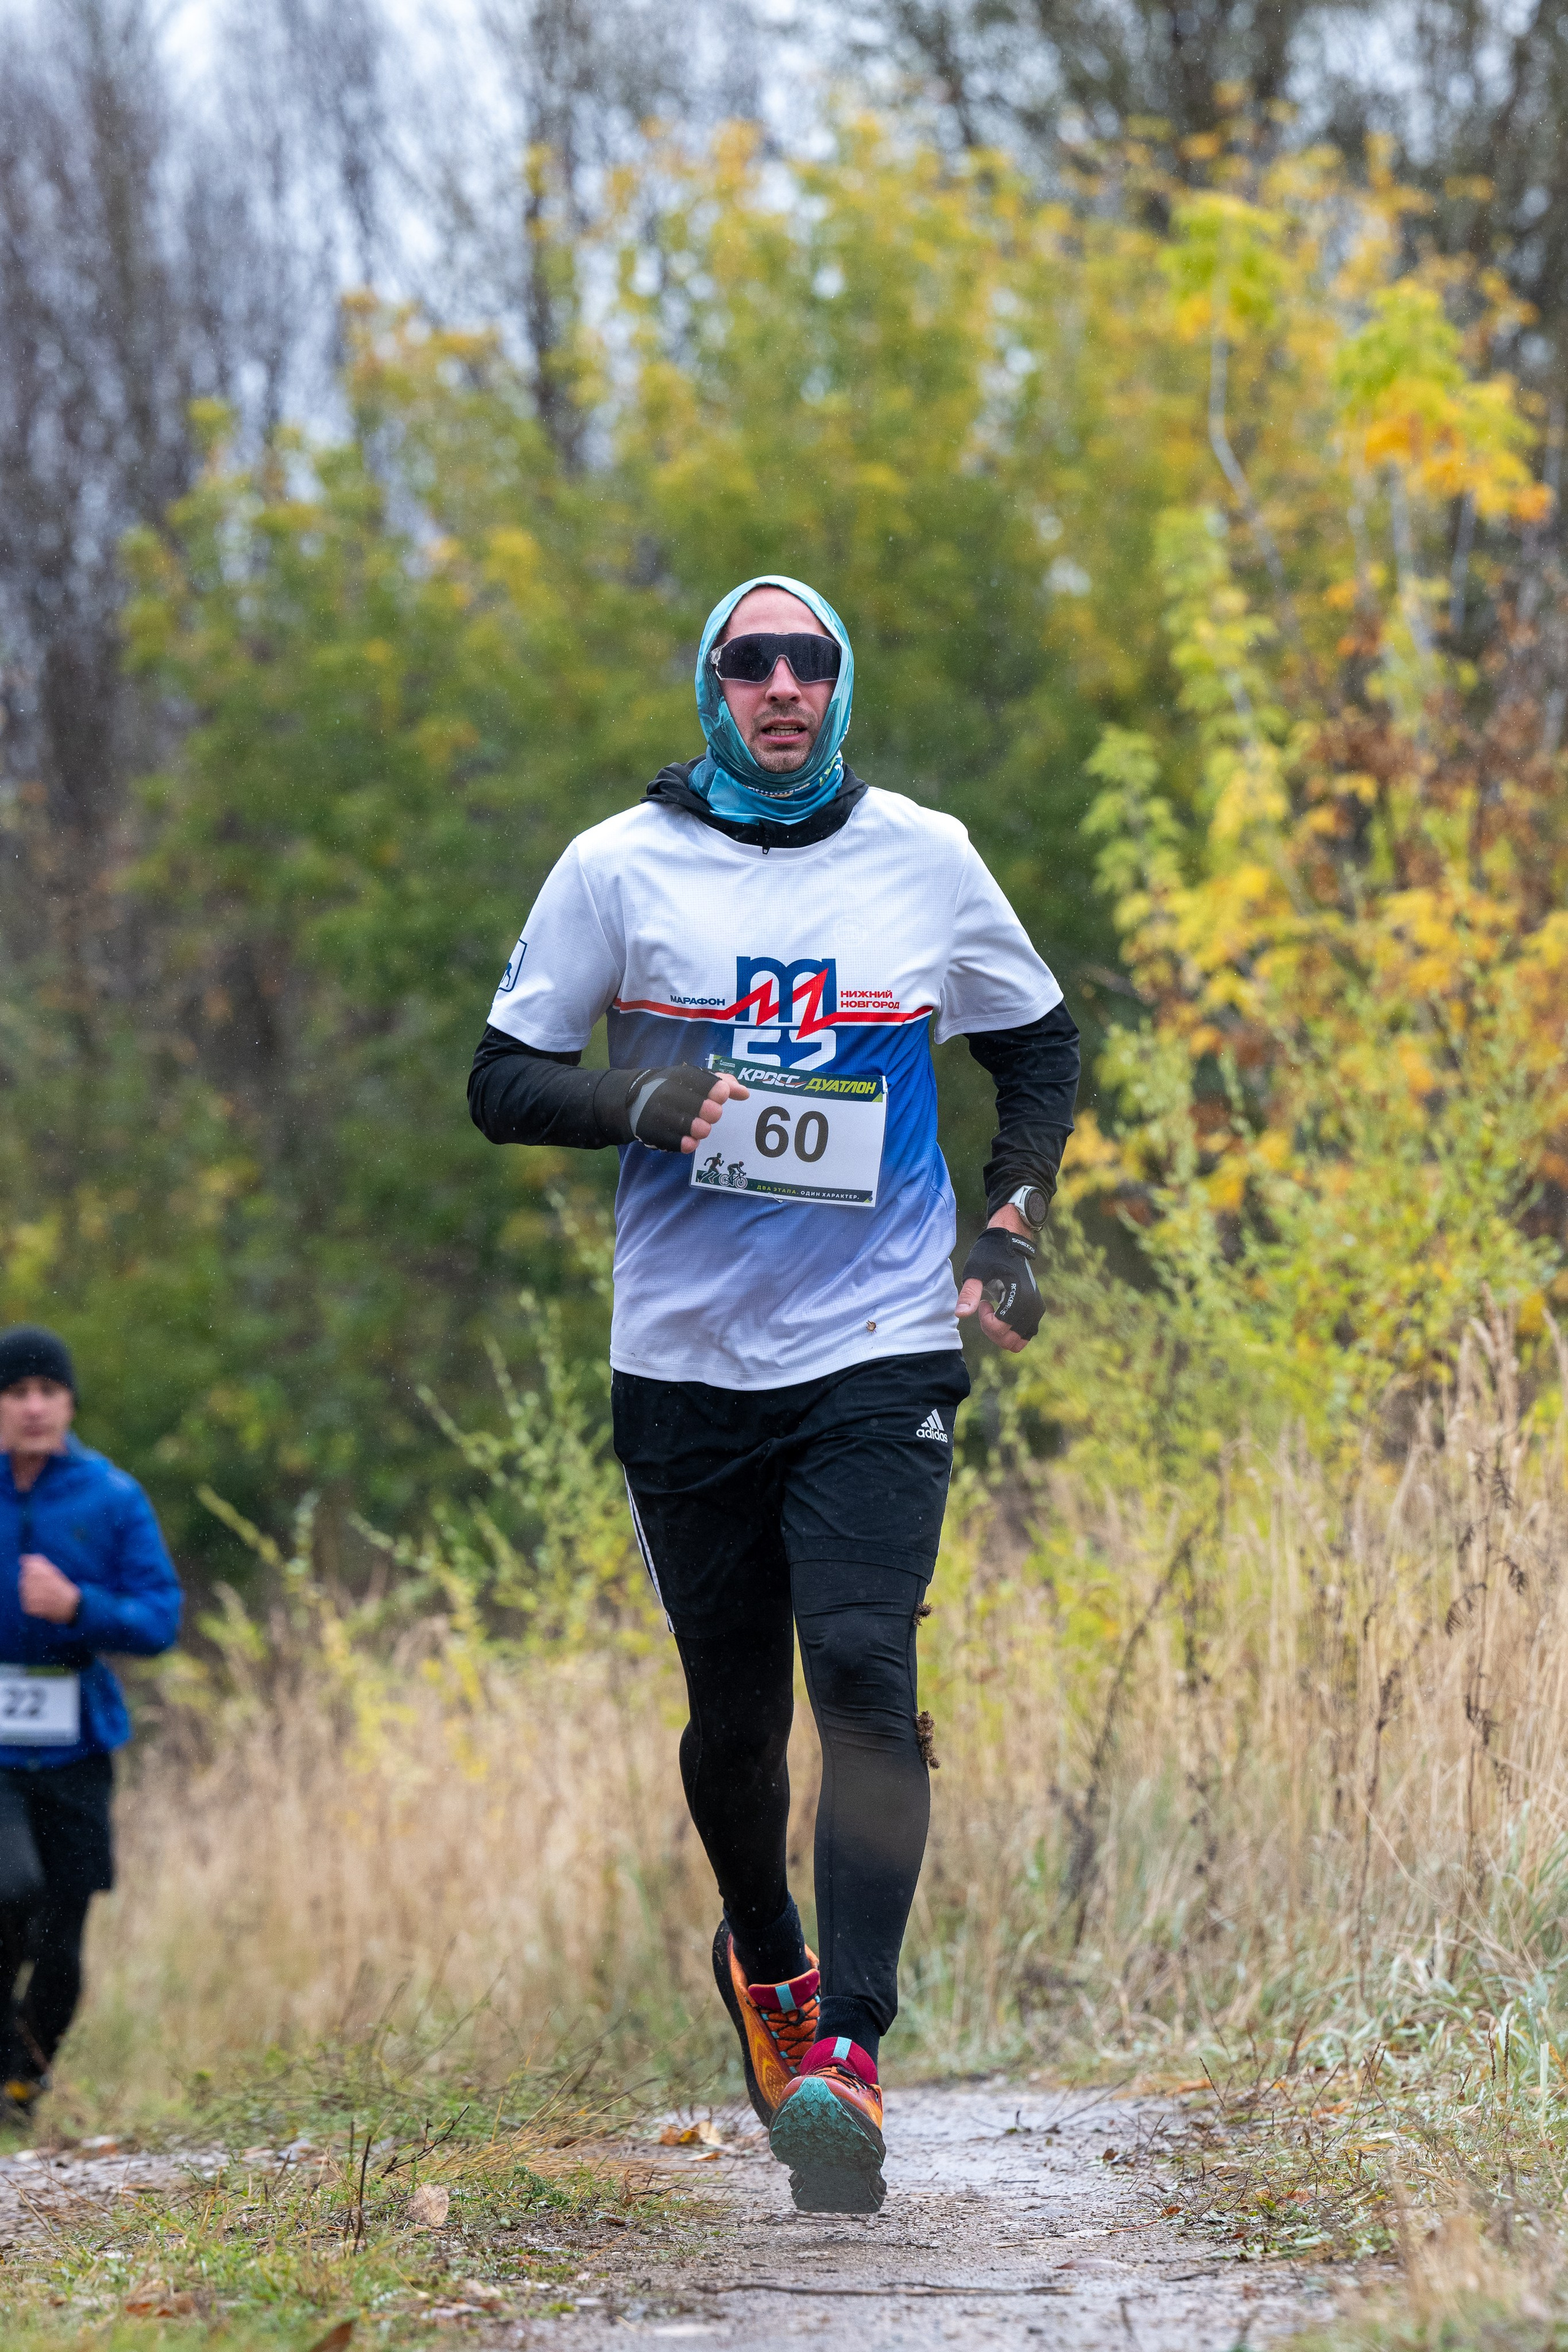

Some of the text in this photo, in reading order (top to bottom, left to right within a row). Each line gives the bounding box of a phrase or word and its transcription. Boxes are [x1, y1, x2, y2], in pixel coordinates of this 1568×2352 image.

[670, 995, 725, 1006] МАРАФОН
[840, 990, 892, 998] НИЖНИЙ
[840, 1000, 900, 1009] НОВГОРОД
[737, 1067, 877, 1095] КРОСС ДУАТЛОН
[755, 1106, 829, 1163] 60
[1000, 1283, 1017, 1316] ROCKBROS
[916, 1427, 948, 1443] adidas
